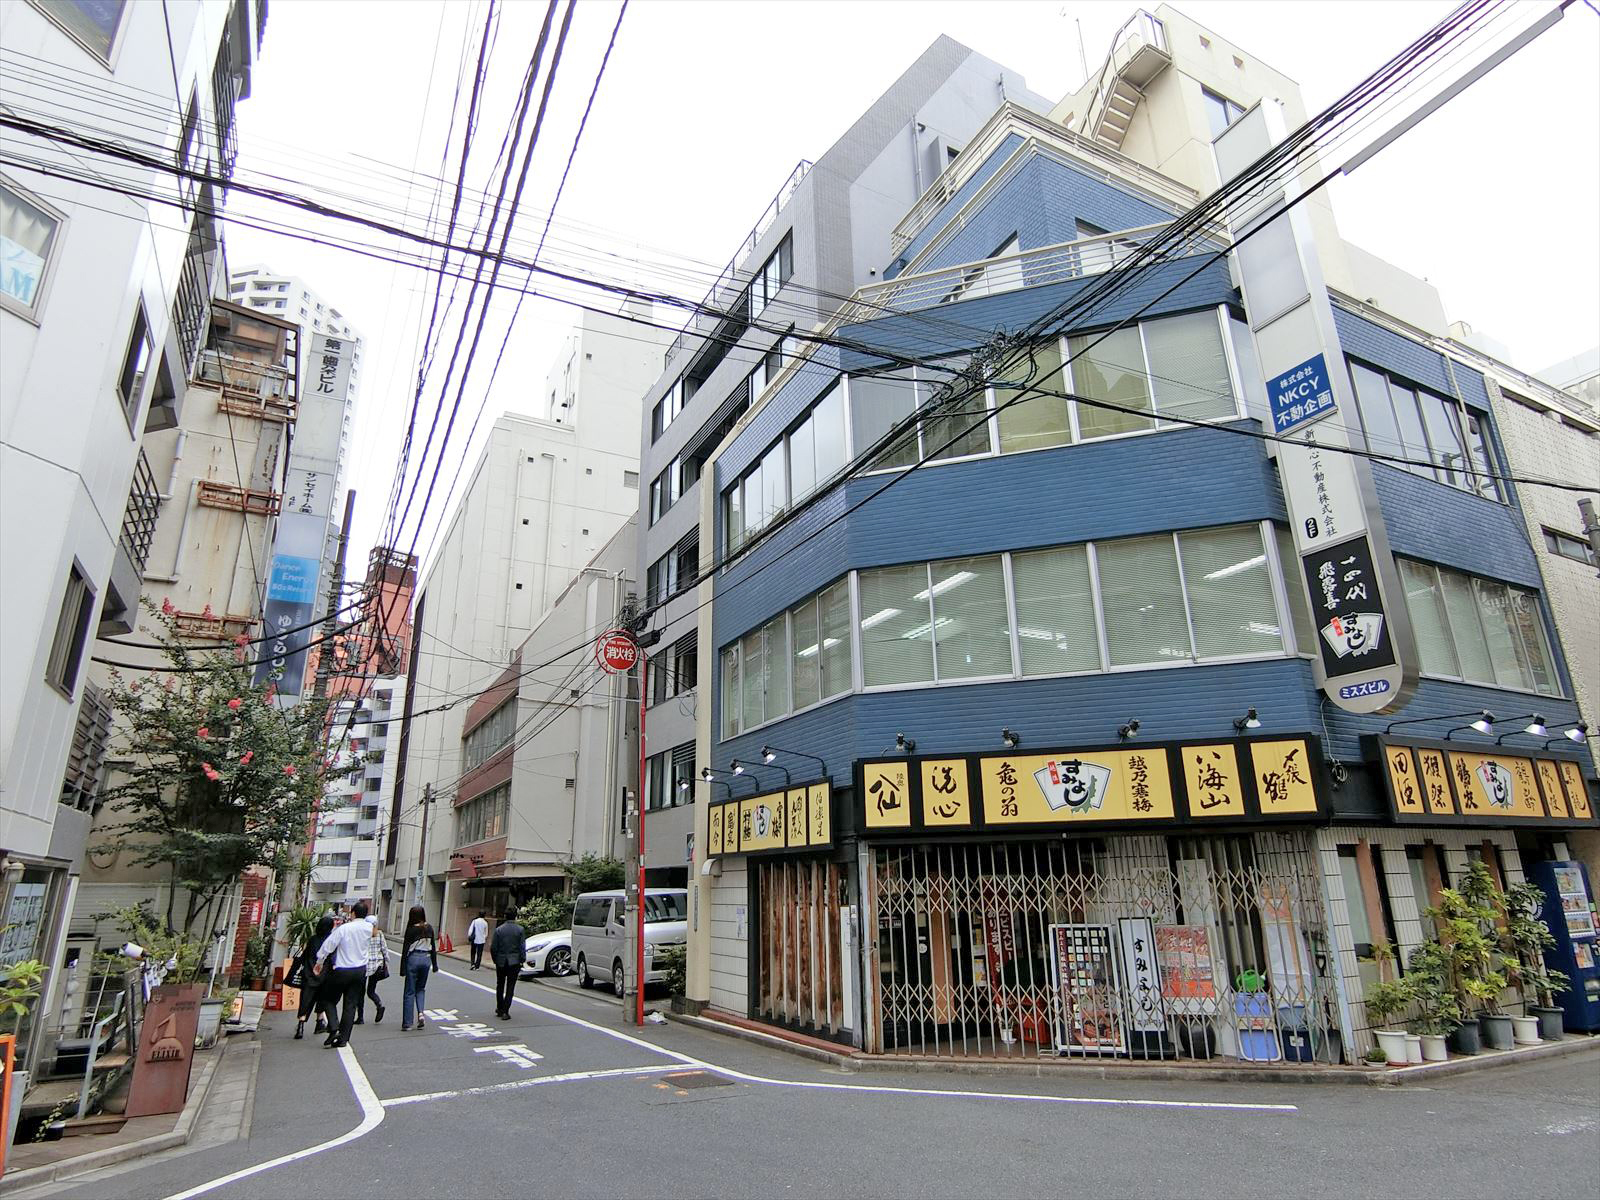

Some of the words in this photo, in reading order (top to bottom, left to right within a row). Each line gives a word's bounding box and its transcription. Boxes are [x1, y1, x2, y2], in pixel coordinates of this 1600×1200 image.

[1278, 376, 1319, 406] NKCY
[1280, 366, 1314, 389] 株式会社
[1277, 389, 1332, 426] 不動企画
[1306, 518, 1317, 538] 2F
[1340, 556, 1367, 600] 十四代
[1342, 613, 1367, 650] すみよし
[606, 646, 634, 661] 消火栓
[1342, 681, 1386, 697] ミスズビル
[1060, 759, 1089, 807] すみよし
[1129, 755, 1154, 813] 越乃寒梅
[1196, 751, 1231, 810] 八海山
[1133, 938, 1153, 1011] すみよし
[151, 1050, 180, 1060] ELIXIR
